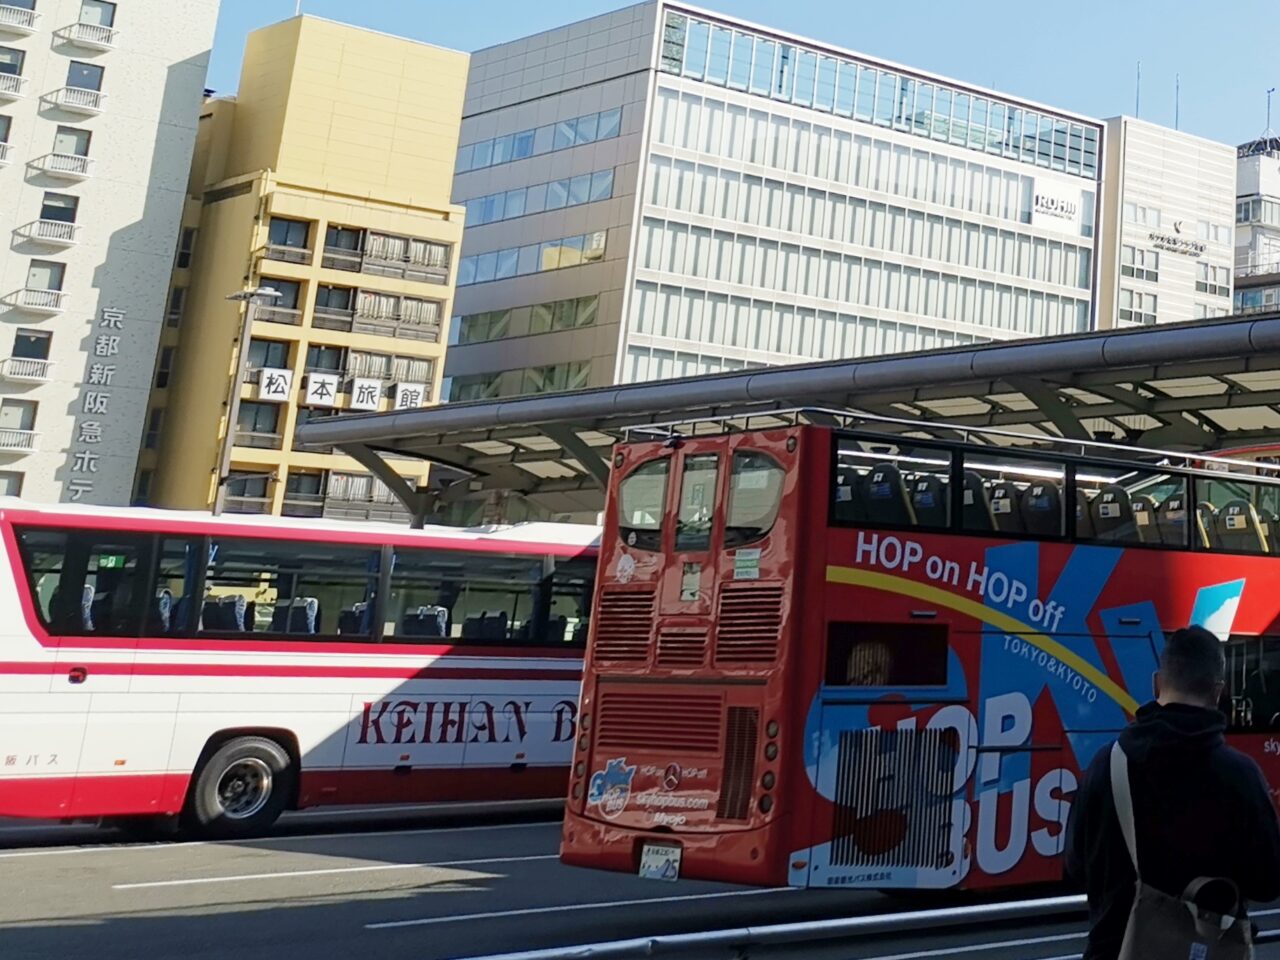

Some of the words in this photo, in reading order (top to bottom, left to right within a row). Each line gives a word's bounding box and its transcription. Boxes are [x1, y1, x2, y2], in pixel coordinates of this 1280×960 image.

[69, 307, 127, 500] 京都新阪急ホテ
[264, 373, 421, 408] 松本旅館
[855, 531, 923, 571] HOP
[926, 555, 960, 586] on
[966, 561, 1028, 608] HOP
[1028, 600, 1066, 633] off
[1003, 635, 1098, 704] TOKYO&KYOTO
[356, 700, 533, 744] KEIHAN
[653, 811, 687, 826] Myojo
